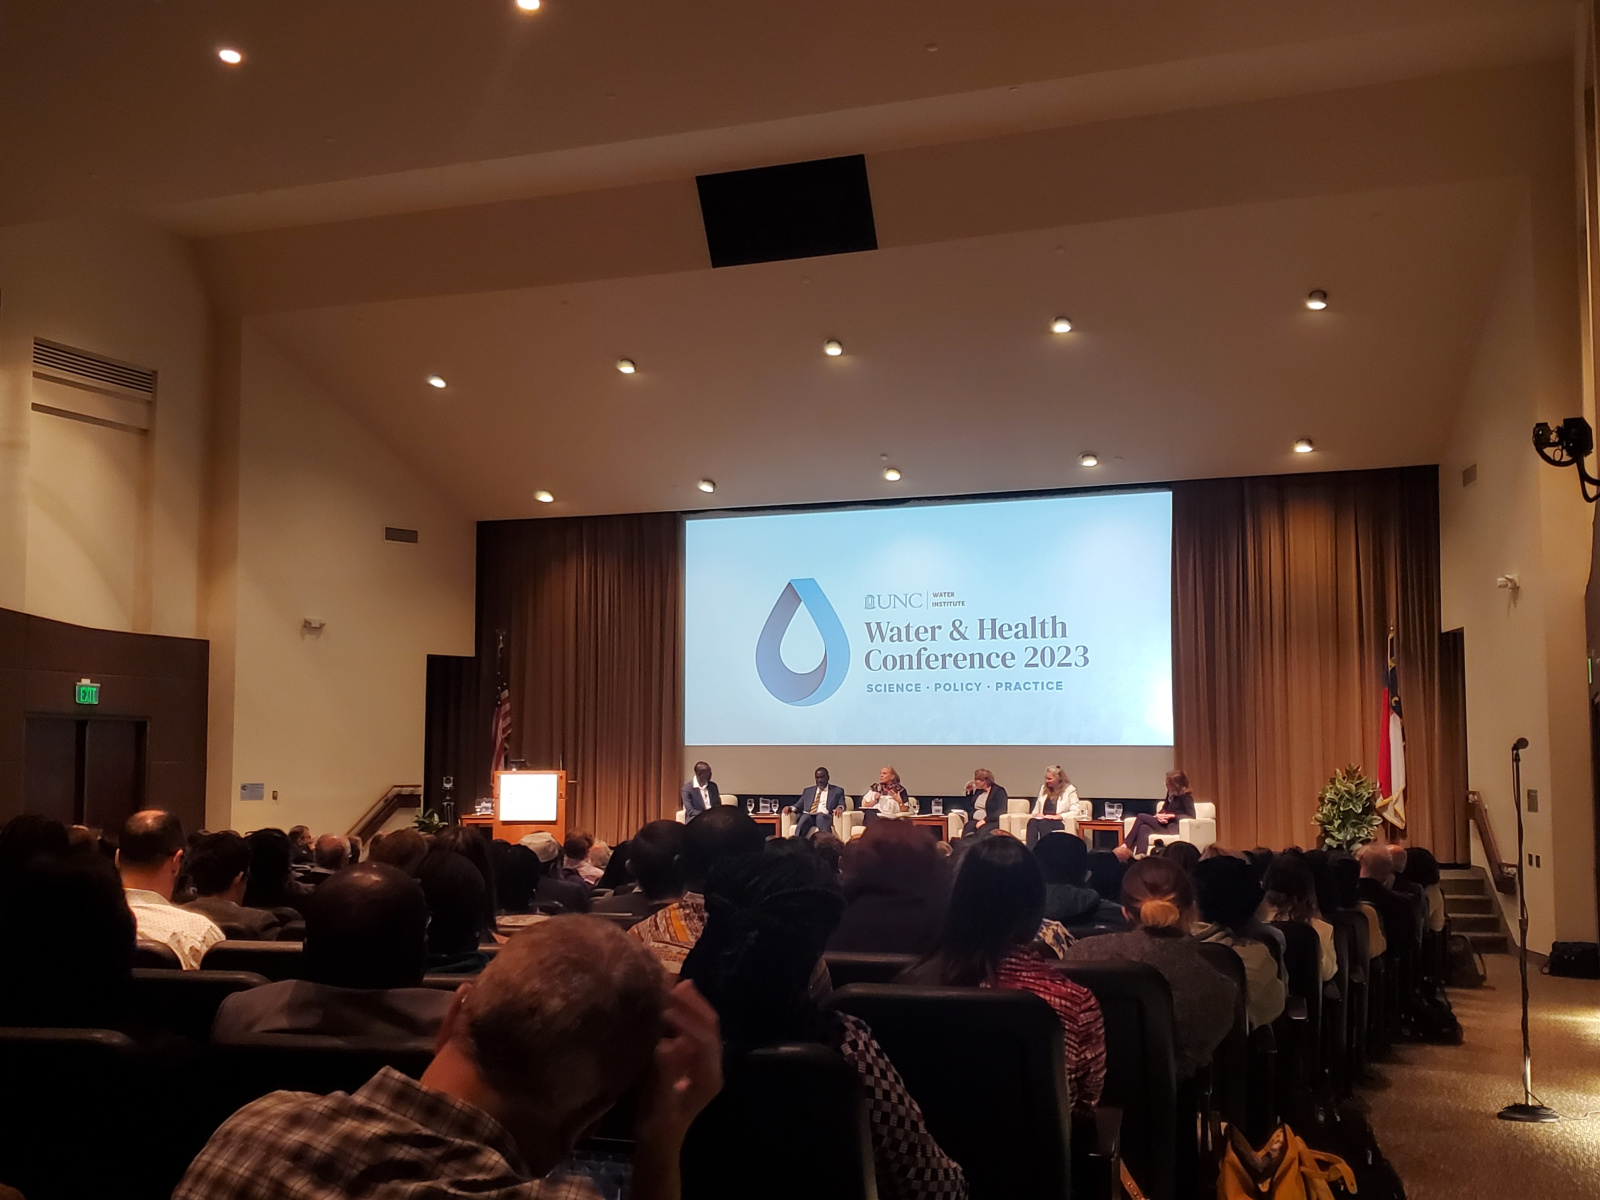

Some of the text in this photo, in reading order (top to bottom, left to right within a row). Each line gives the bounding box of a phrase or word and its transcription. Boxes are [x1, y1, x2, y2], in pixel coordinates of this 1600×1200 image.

[878, 593, 922, 609] UNC
[932, 600, 965, 608] INSTITUTE
[864, 615, 1067, 643] Water & Health
[864, 645, 1089, 671] Conference 2023
[866, 681, 1063, 692] SCIENCE POLICY PRACTICE
[80, 687, 97, 703] EXIT
